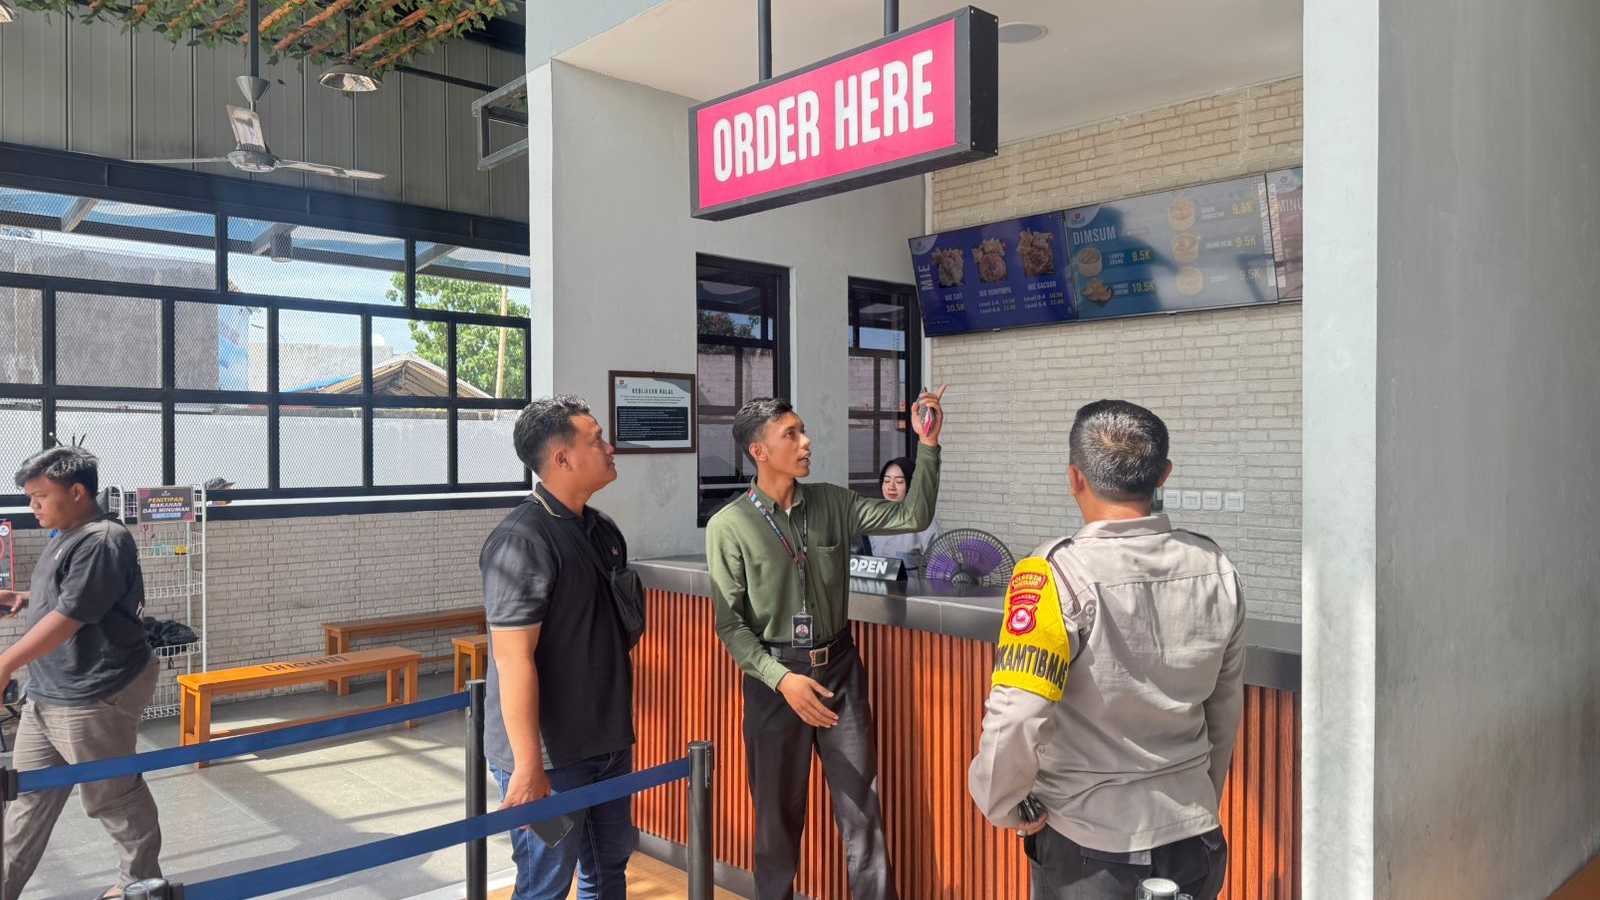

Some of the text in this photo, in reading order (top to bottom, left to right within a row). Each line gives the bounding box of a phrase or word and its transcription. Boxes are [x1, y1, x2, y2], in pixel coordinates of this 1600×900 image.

[713, 49, 934, 182] ORDER HERE
[1073, 226, 1116, 245] DIMSUM
[1131, 250, 1151, 262] 9.5K
[918, 264, 934, 291] MIE
[946, 303, 966, 313] 10.5K
[850, 558, 888, 575] OPEN
